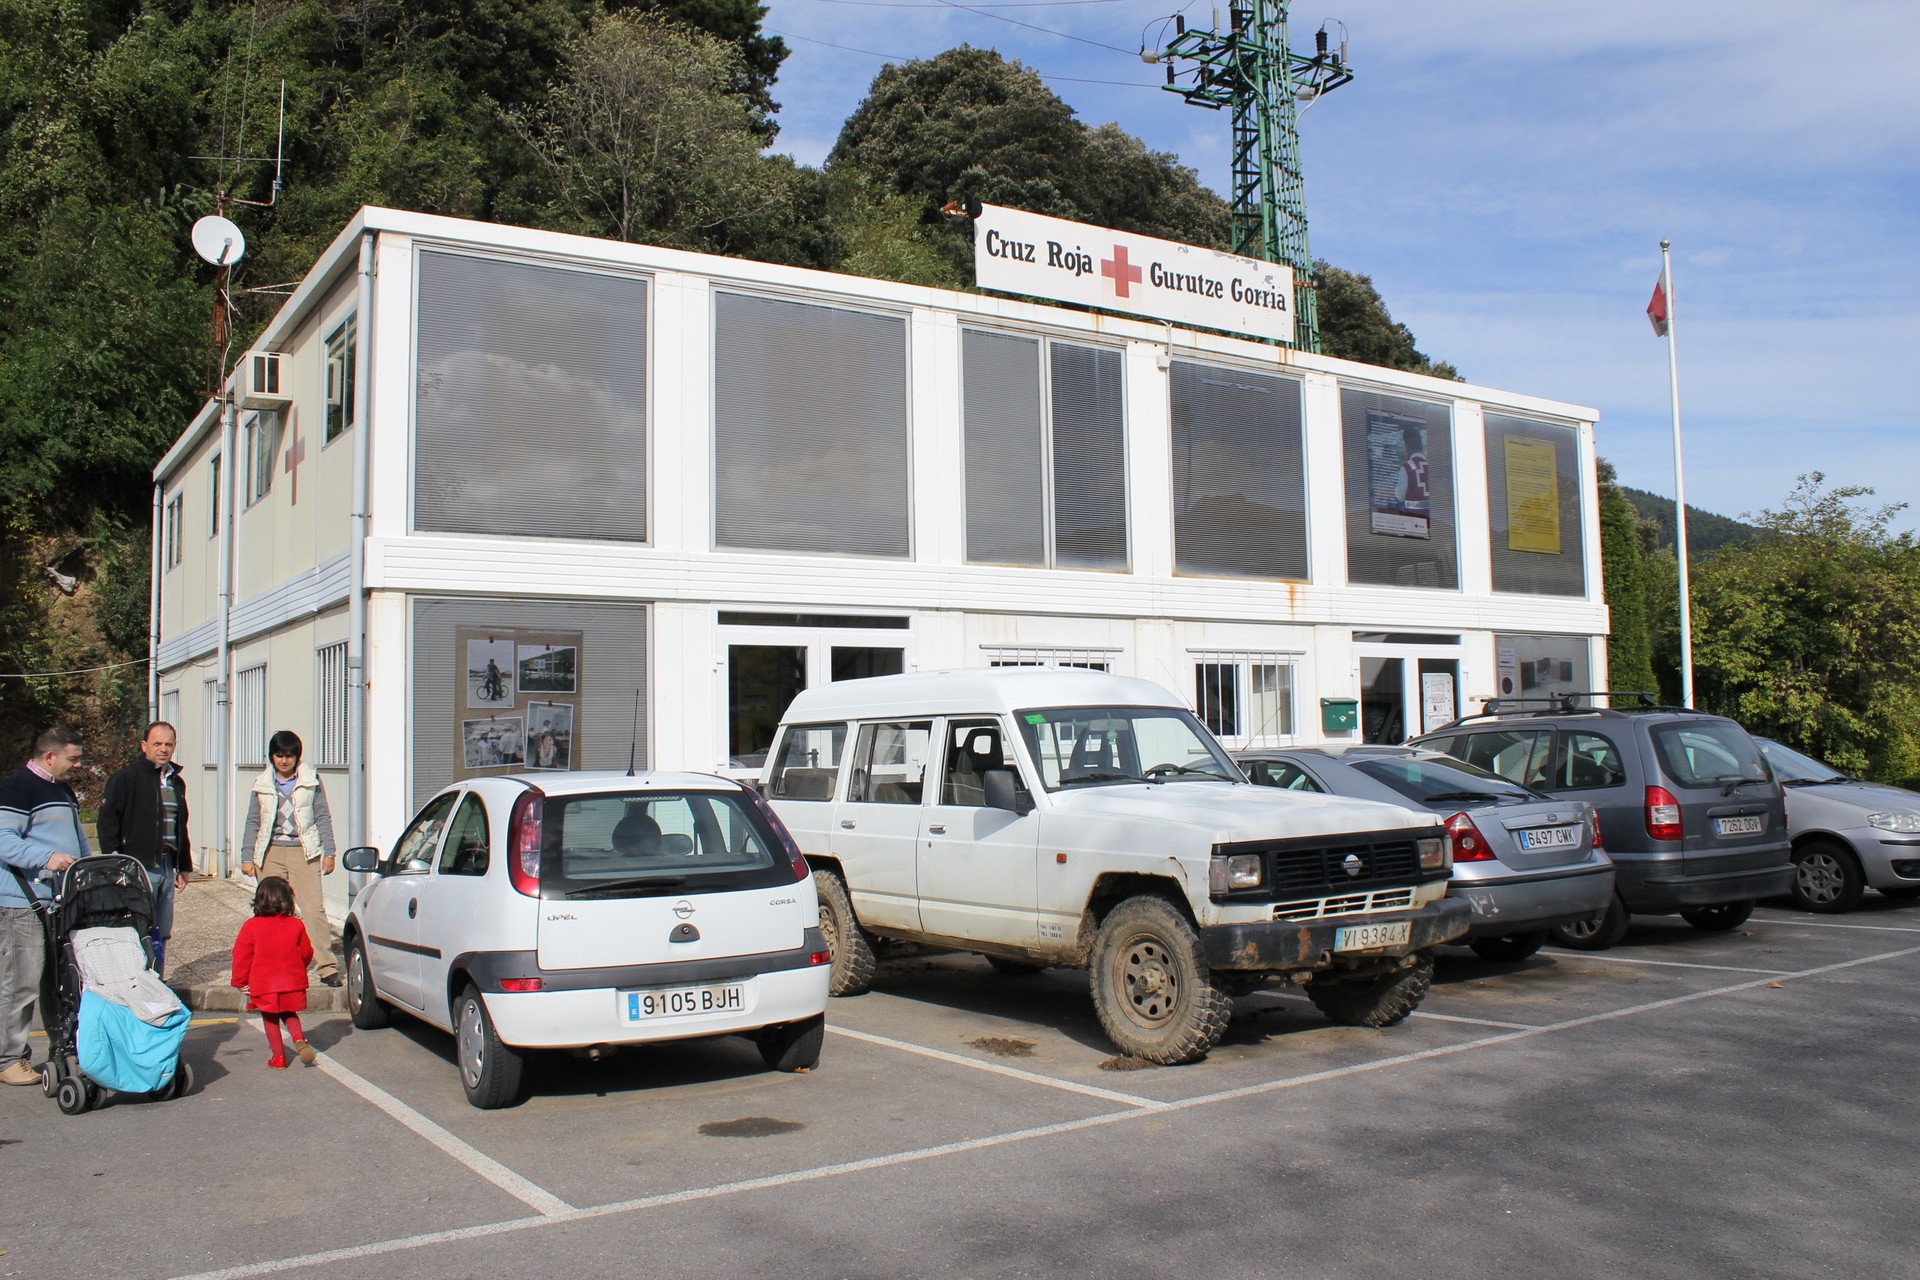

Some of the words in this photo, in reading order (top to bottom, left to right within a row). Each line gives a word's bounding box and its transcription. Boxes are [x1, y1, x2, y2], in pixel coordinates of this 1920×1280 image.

[986, 229, 1035, 264] Cruz
[1047, 240, 1093, 277] Roja
[1150, 261, 1223, 299] Gurutze
[1231, 277, 1287, 312] Gorria
[1721, 819, 1743, 832] 7262
[1527, 830, 1552, 846] 6497
[1555, 828, 1575, 844] CMK
[769, 898, 797, 906] CORSA
[547, 913, 578, 921] OPEL
[643, 991, 696, 1015] 9105
[702, 988, 740, 1010] BJH
